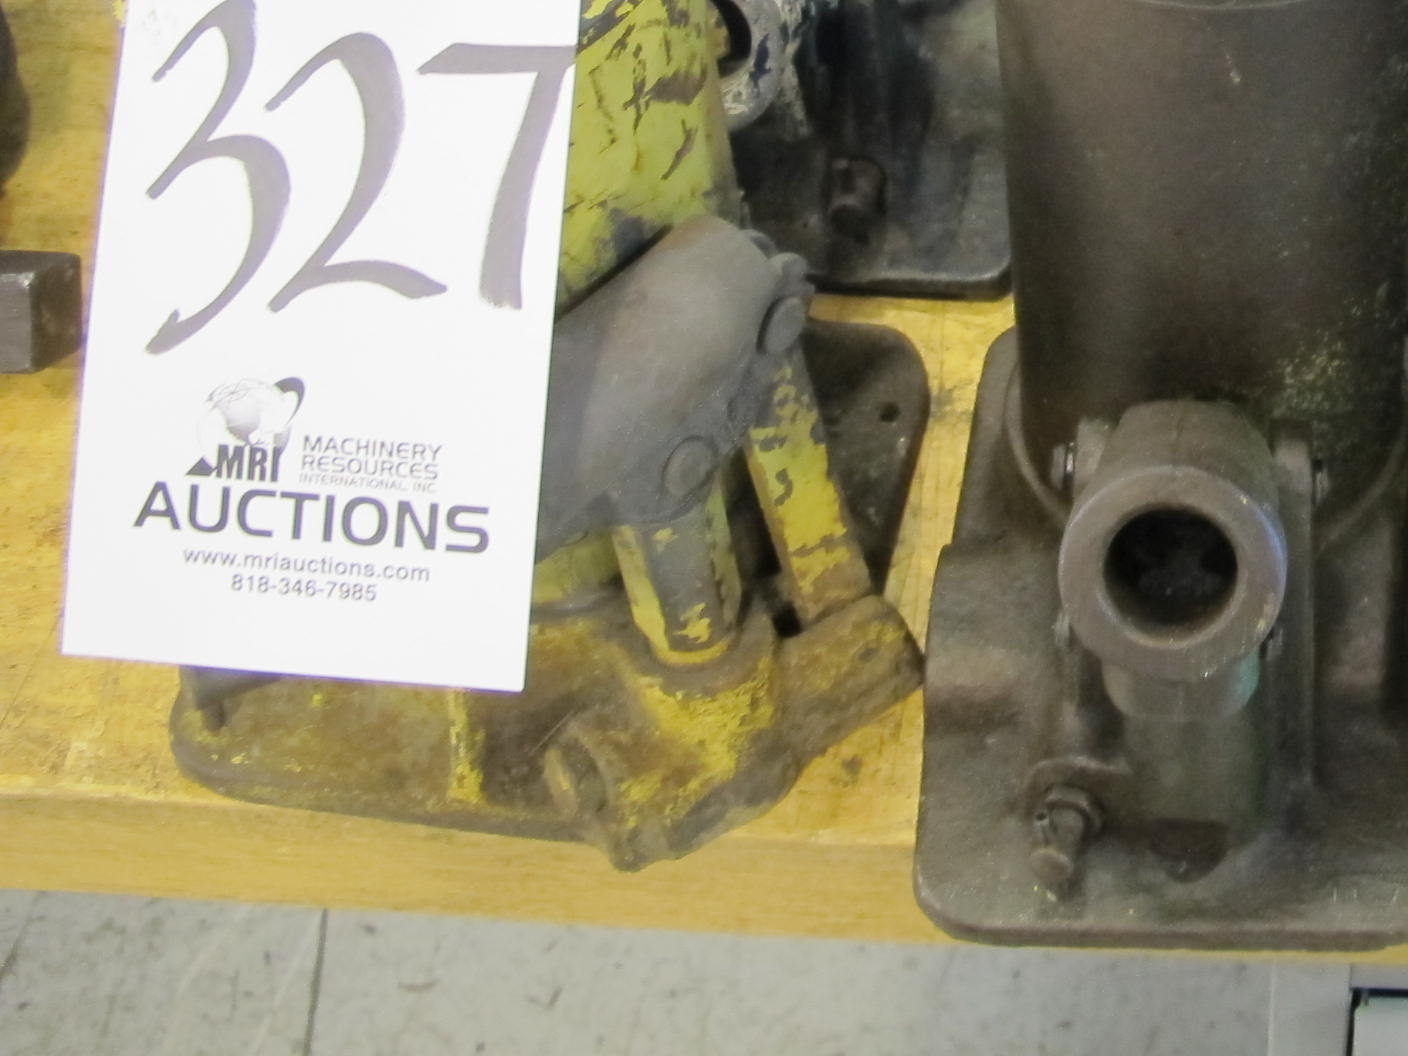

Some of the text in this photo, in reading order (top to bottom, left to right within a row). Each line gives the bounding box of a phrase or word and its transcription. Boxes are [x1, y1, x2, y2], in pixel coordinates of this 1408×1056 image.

[303, 435, 442, 461] MACHINERY
[215, 444, 283, 482] MRI
[301, 455, 439, 480] RESOURCES
[299, 473, 406, 491] INTERNATIONAL
[133, 481, 490, 554] AUCTIONS
[183, 548, 430, 583] www.mriauctions.com
[230, 574, 378, 602] 818-346-7985
